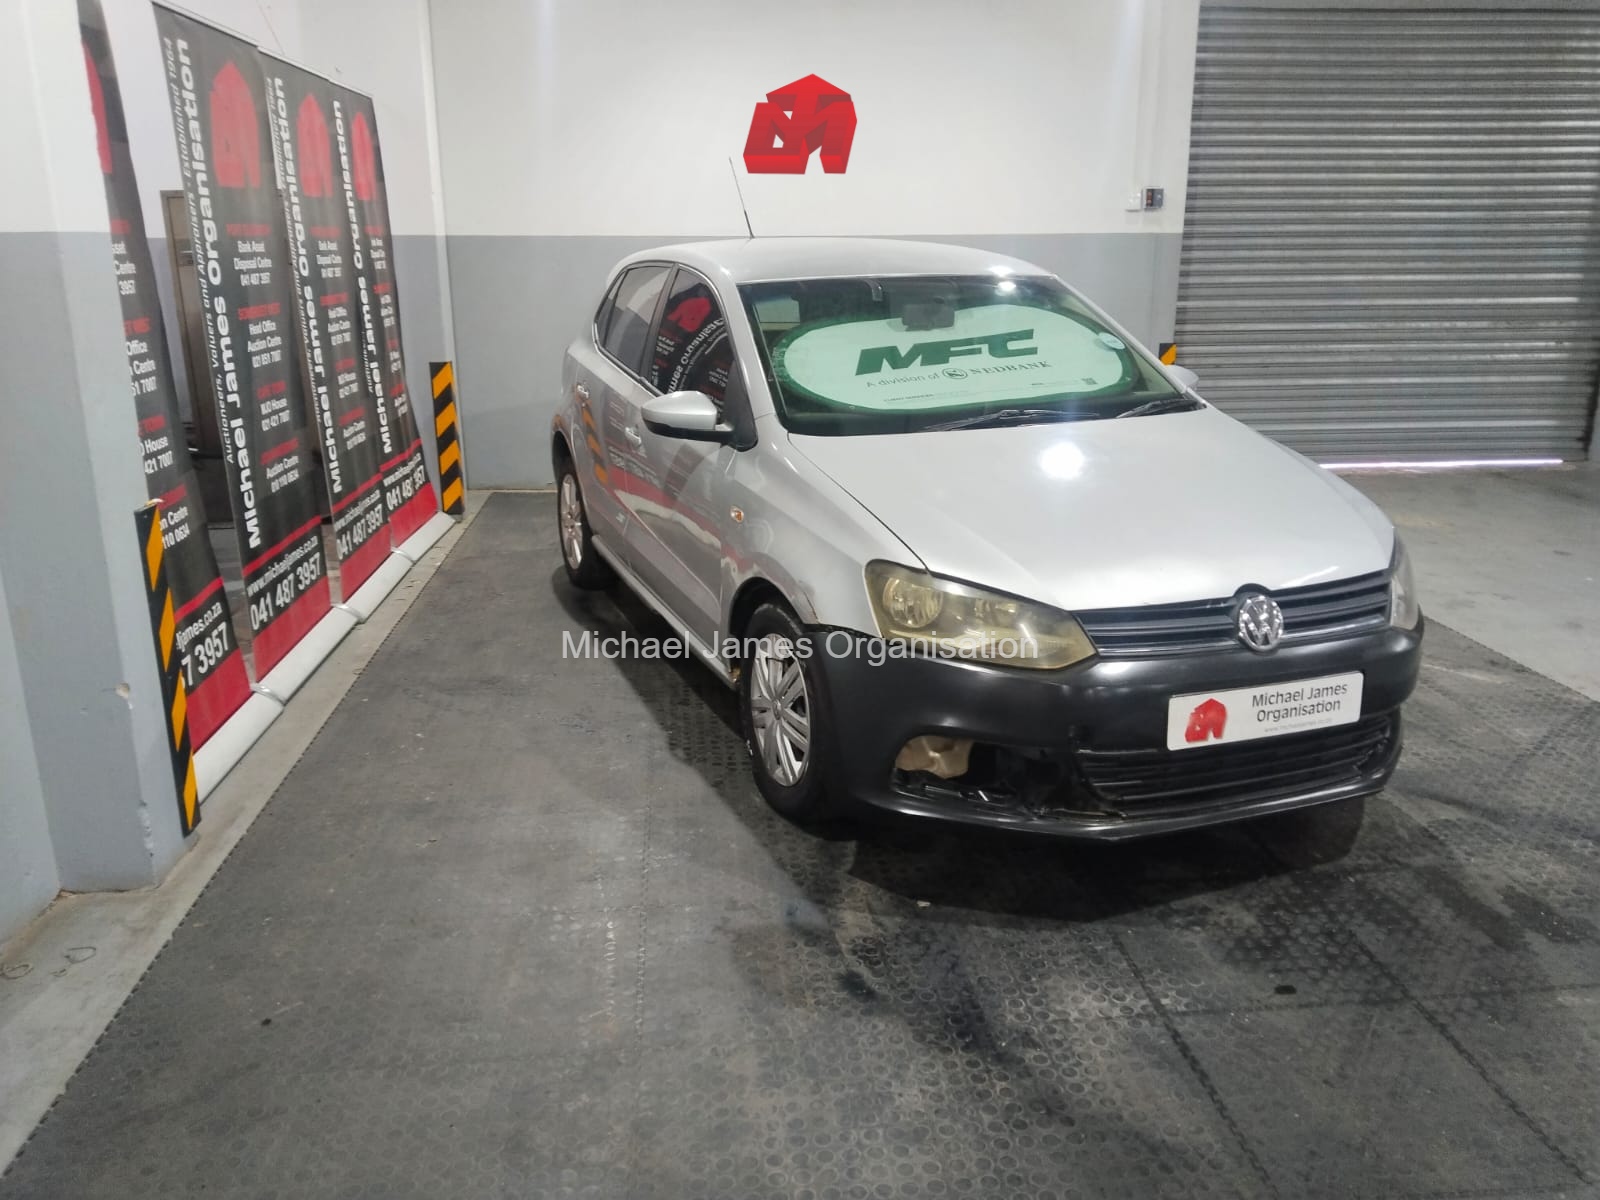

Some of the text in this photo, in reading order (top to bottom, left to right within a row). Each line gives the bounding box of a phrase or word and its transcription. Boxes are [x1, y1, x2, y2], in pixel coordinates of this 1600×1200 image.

[333, 100, 364, 270] Organisation
[176, 38, 262, 549] Michael James Organisation
[199, 277, 211, 309] and
[274, 77, 343, 494] Michael James Organisation
[358, 276, 377, 356] James
[855, 328, 1039, 377] MFC
[878, 374, 926, 388] division
[928, 372, 941, 381] of
[970, 360, 1053, 376] NEDBANK
[369, 361, 393, 454] Michael
[144, 436, 169, 453] House
[386, 485, 403, 511] 041
[336, 503, 383, 561] 041 487 3957
[250, 551, 321, 631] 041 487 3957
[194, 620, 230, 675] 3957
[1252, 684, 1348, 709] Michael James
[1256, 700, 1341, 722] Organisation
